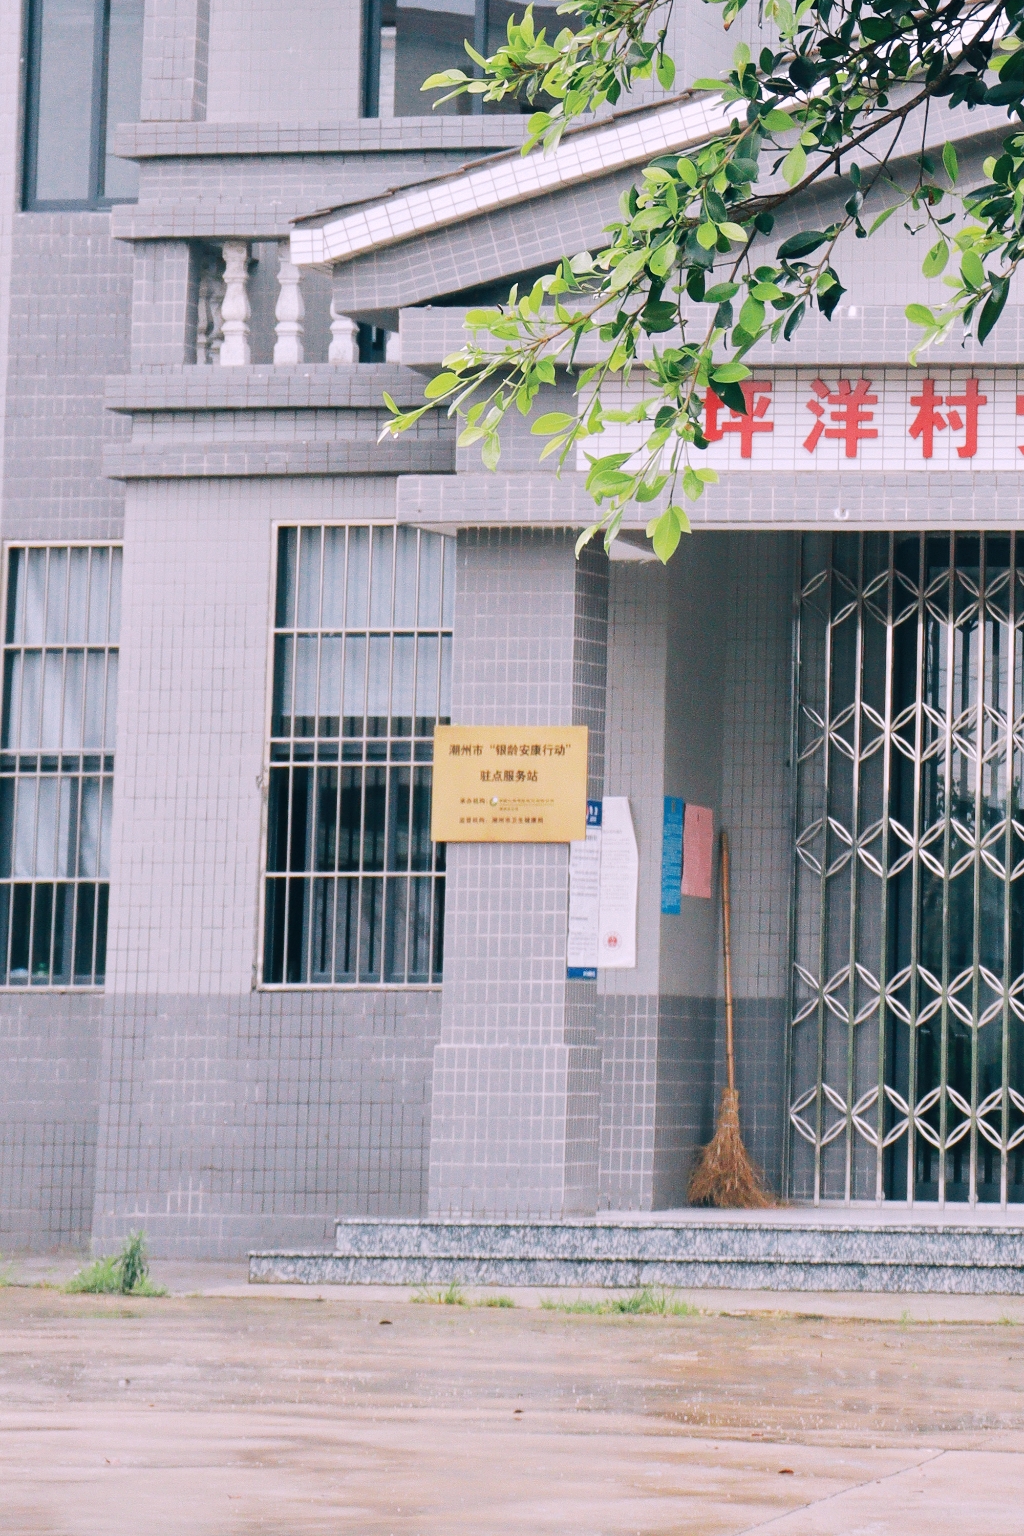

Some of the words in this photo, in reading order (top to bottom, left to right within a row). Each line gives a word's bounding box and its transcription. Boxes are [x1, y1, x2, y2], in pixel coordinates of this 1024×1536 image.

[480, 769, 538, 782] 驻点服务站
